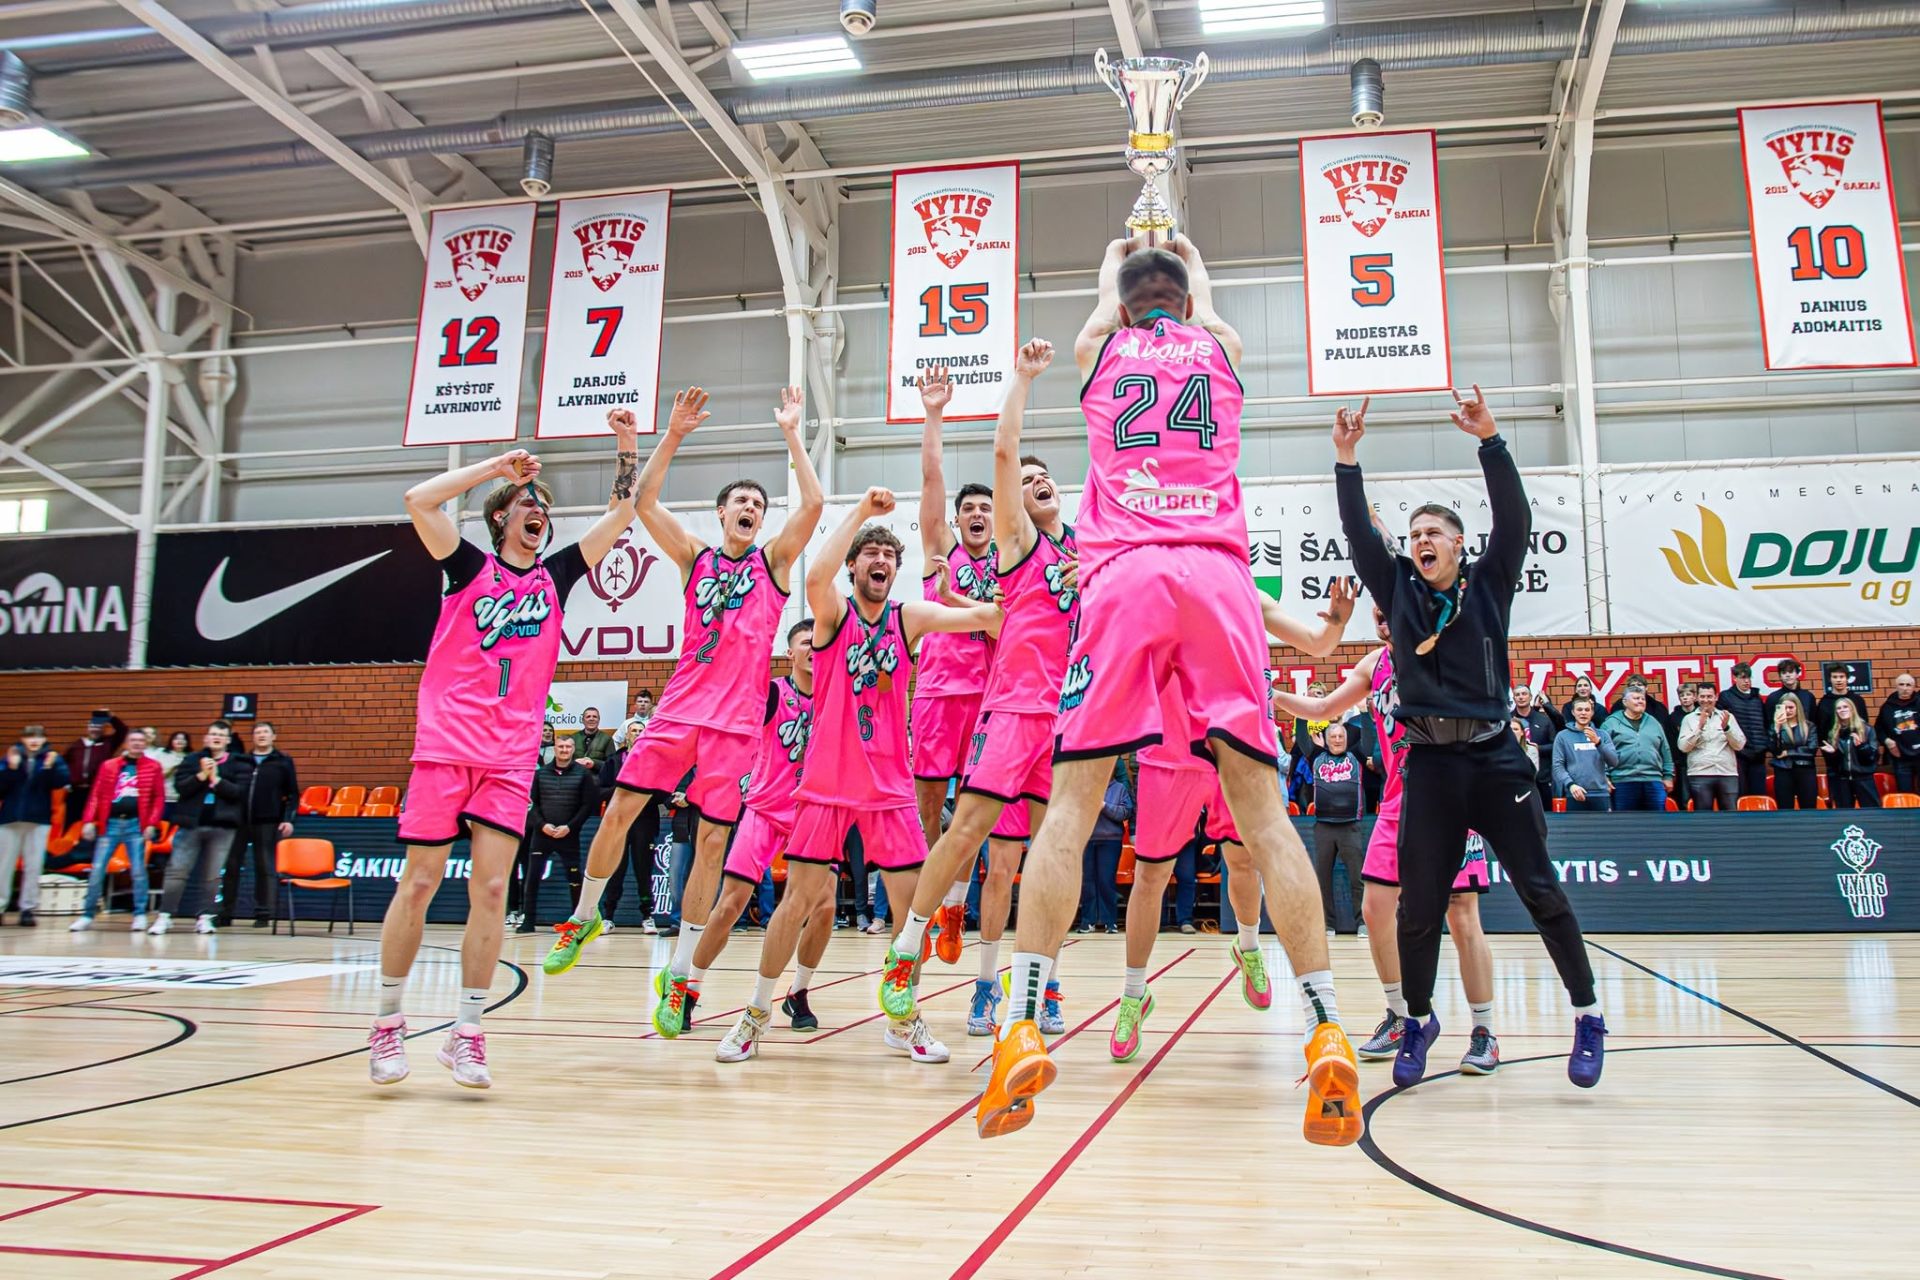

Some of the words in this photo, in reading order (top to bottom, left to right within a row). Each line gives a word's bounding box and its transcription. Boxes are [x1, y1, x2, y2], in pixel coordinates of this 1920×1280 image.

[1766, 131, 1854, 159] VYTIS
[1323, 161, 1408, 189] VYTIS
[1765, 186, 1789, 195] 2015
[914, 194, 992, 221] VYTIS
[1319, 215, 1341, 223] 2015
[445, 230, 512, 256] VYTIS
[573, 219, 646, 246] VYTIS
[907, 246, 927, 255] 2015
[1787, 225, 1868, 281] 10
[564, 270, 584, 279] 2015
[1350, 253, 1395, 307] 5
[919, 282, 989, 337] 15
[1801, 300, 1867, 313] DAINIUS
[586, 306, 624, 358] 7
[1336, 325, 1418, 340] MODESTAS
[1791, 319, 1882, 334] ADOMAITIS
[438, 316, 500, 367] 12
[1140, 340, 1213, 360] DOJUS
[1325, 344, 1431, 360] PAULAUSKAS
[916, 354, 989, 369] GVIDONAS
[573, 371, 626, 388] DARJUŠ
[902, 370, 1002, 387] MAEVIČIUS
[425, 397, 501, 415] LAVRINOVIČ
[558, 390, 639, 408] LAVRINOVIČ
[1113, 373, 1217, 451] 24
[1619, 490, 1734, 504] VYČIO
[1738, 527, 1920, 579] DOJU
[473, 588, 551, 651] Vytis
[518, 622, 541, 637] VDU
[561, 625, 675, 655] VDU
[696, 629, 719, 663] 2
[499, 658, 512, 697] 1
[232, 696, 248, 712] D
[857, 704, 874, 741] 6
[334, 852, 407, 882] ŠAKIŲ
[444, 859, 473, 878] TIS
[1551, 860, 1619, 882] YTIS
[1646, 860, 1711, 882] VDU
[1837, 873, 1888, 897] VYTIS
[1848, 895, 1885, 918] VDU
